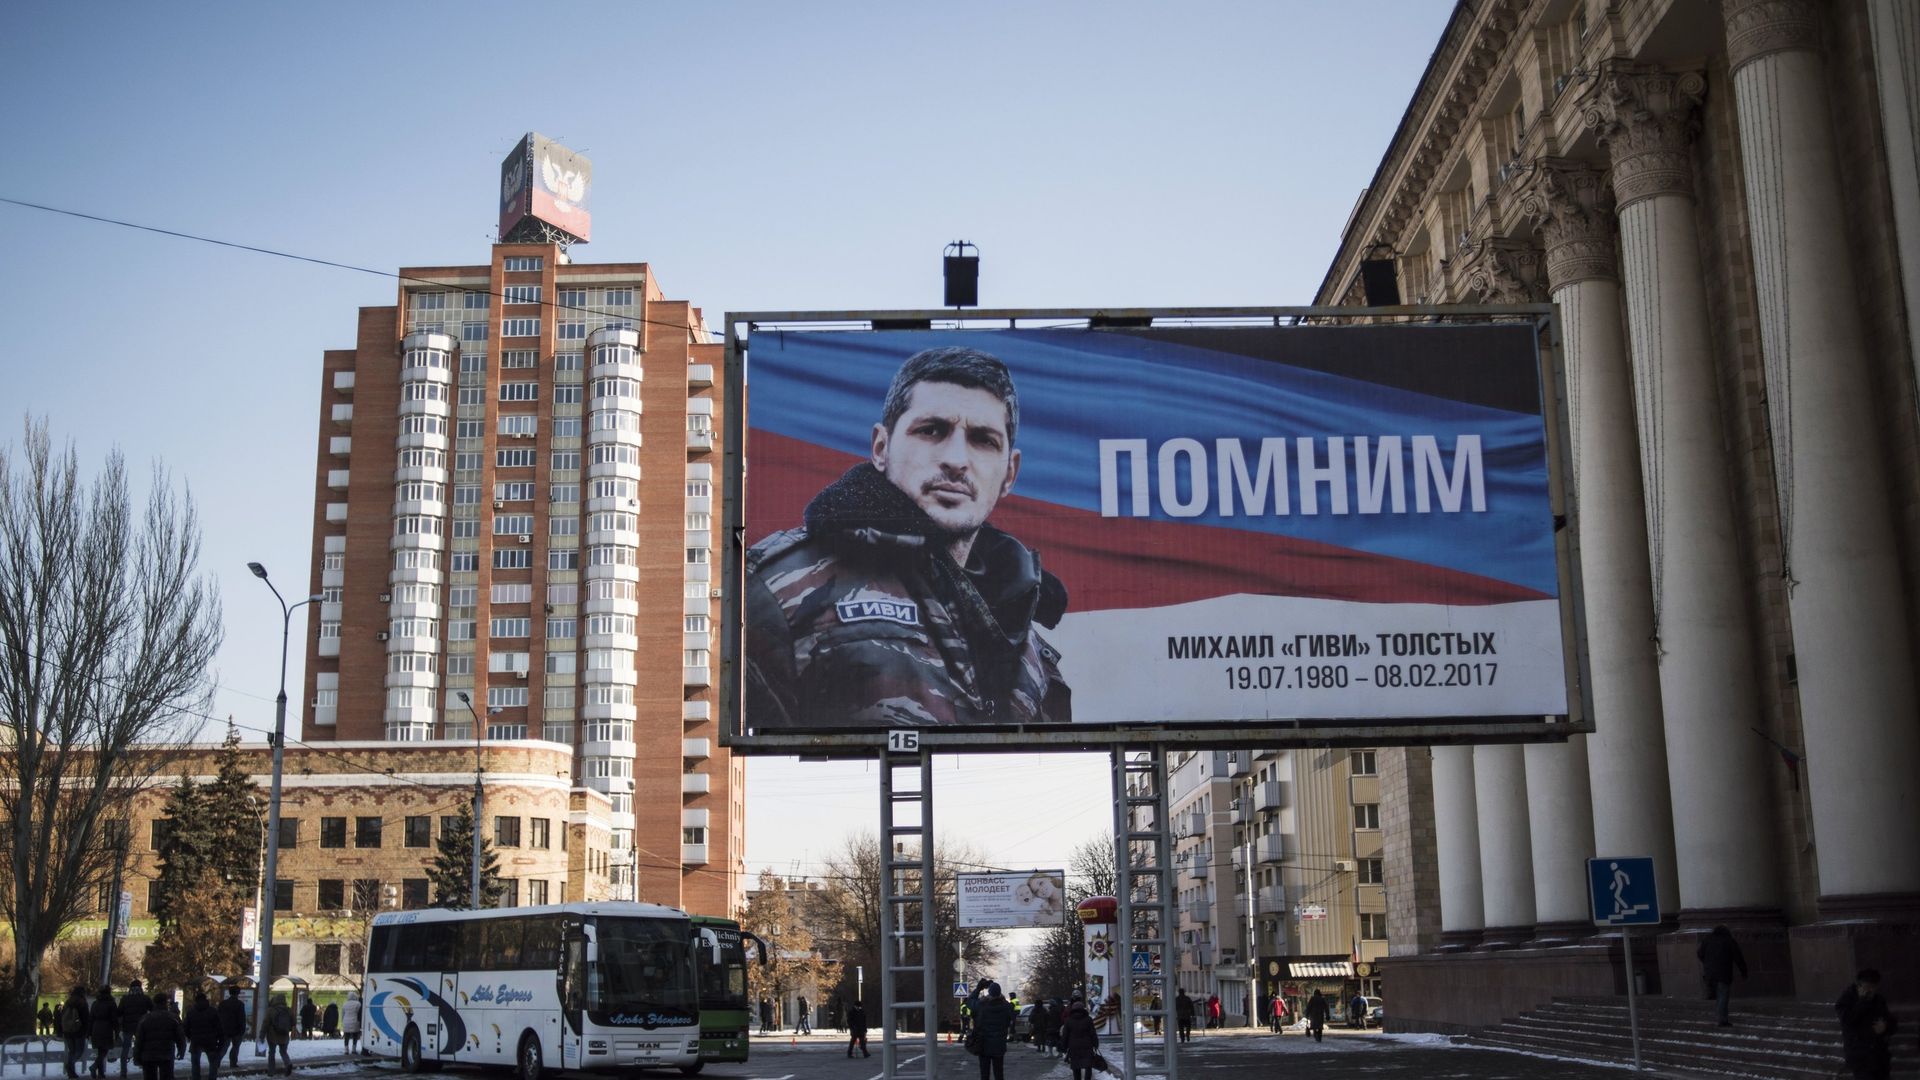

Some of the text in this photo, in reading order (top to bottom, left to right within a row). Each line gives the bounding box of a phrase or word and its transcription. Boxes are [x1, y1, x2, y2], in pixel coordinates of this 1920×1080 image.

[1099, 434, 1486, 517] ПОМНИМ
[844, 602, 911, 620] ГИВИ
[1167, 631, 1497, 660] МИХАИЛ «ГИВИ» ТОЛСТЫХ
[1225, 664, 1349, 690] 19.07.1980
[1374, 662, 1498, 688] 08.02.2017
[890, 732, 918, 749] 1Б
[964, 877, 1005, 886] ДОНБАСС
[965, 885, 1011, 893] МОЛОДЕЕТ
[702, 939, 734, 949] Exess
